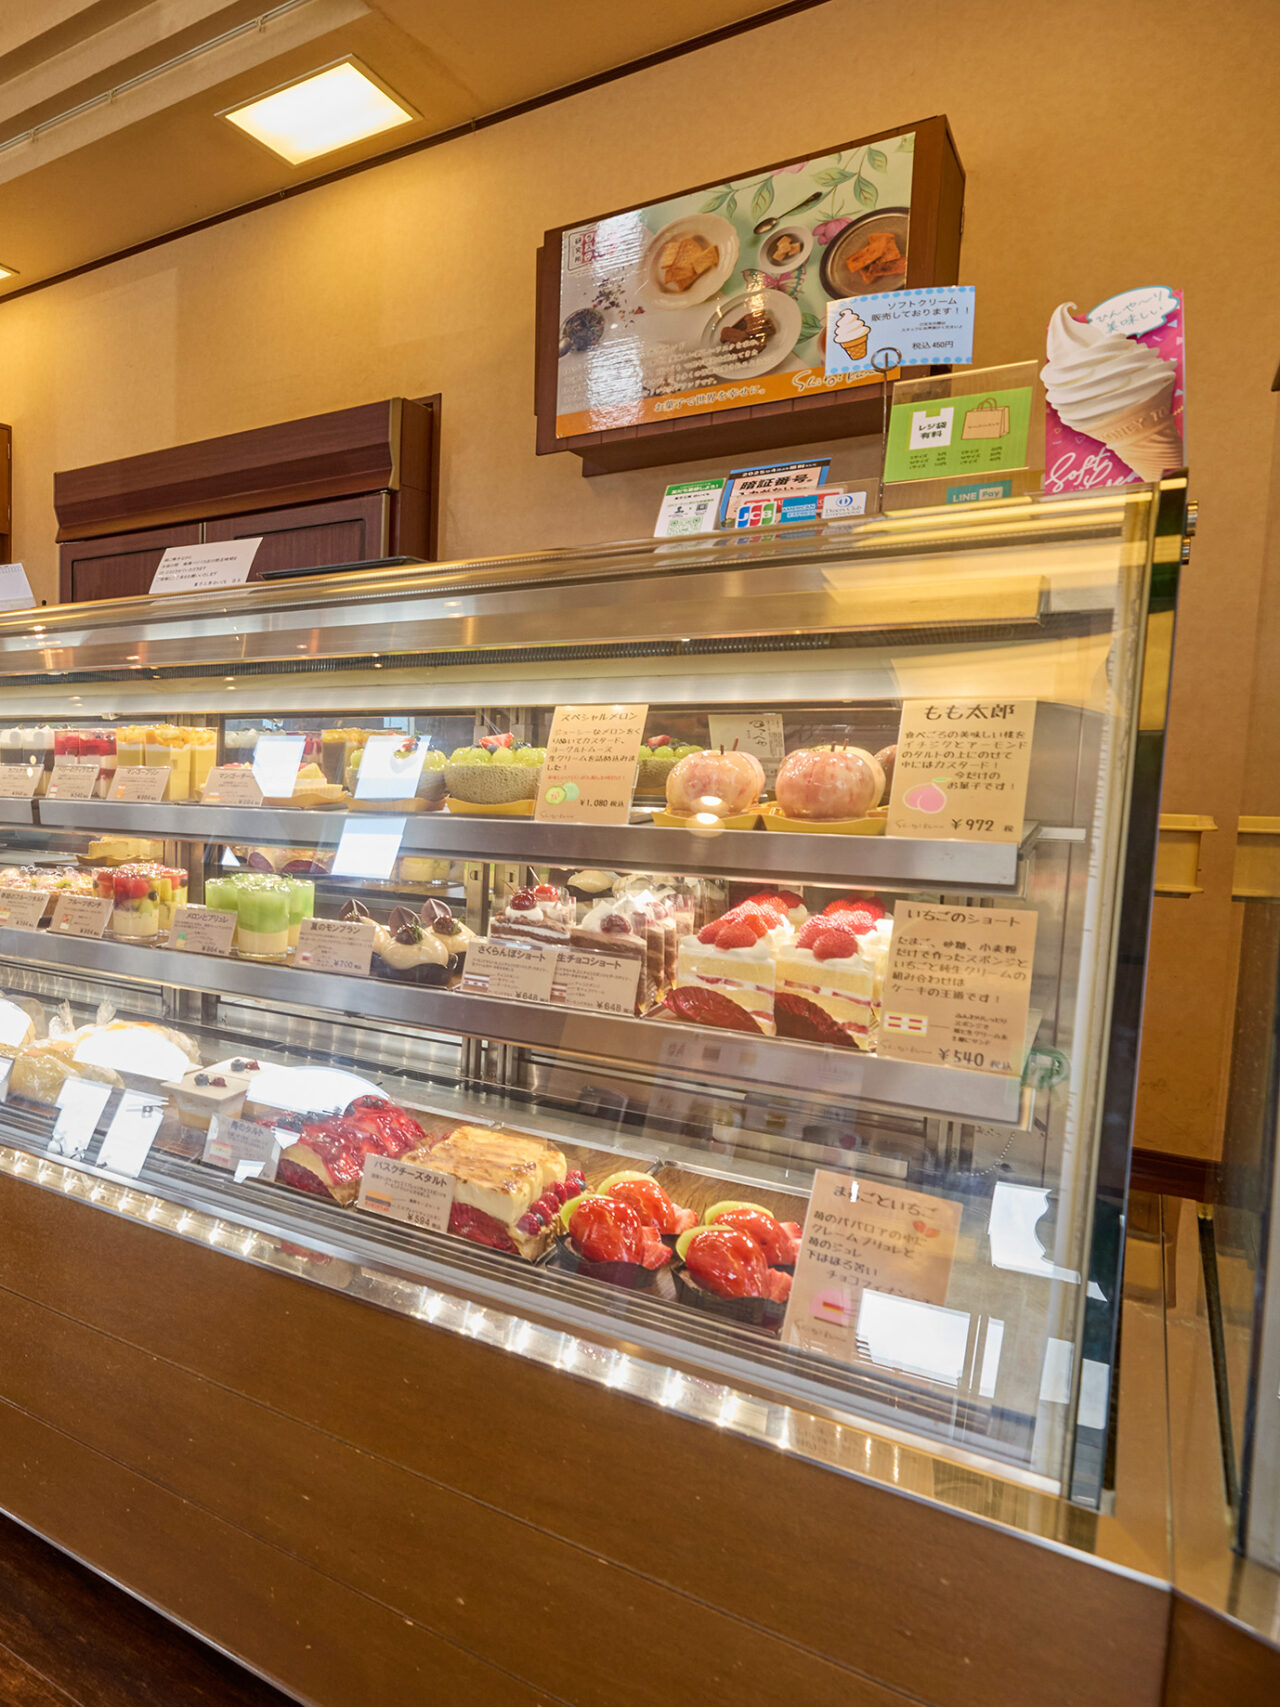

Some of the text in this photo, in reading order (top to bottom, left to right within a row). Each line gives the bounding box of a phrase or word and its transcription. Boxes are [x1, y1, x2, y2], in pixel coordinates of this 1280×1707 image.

[887, 297, 958, 311] ソフトクリーム
[871, 306, 970, 321] 販売しております！！
[1106, 305, 1164, 333] 美味しい
[912, 340, 954, 349] 税込 450円
[952, 489, 1000, 503] LINE Pay
[561, 713, 638, 721] スペシャルメロン
[925, 704, 1016, 721] もも太郎
[901, 751, 1013, 760] のタルトの上にのせて
[954, 771, 1001, 781] 今だけの
[946, 782, 1015, 791] お菓子です！
[951, 818, 995, 832] ¥972
[907, 909, 1021, 928] いちごのショート
[478, 945, 546, 962] さくらんぼショート
[556, 952, 622, 970] 生チョコショート
[891, 971, 965, 987] 組み合わせは
[938, 1047, 985, 1067] ¥540
[374, 1161, 448, 1188] バスクチーズタルト
[806, 1249, 879, 1277] 下はほろ苦い
